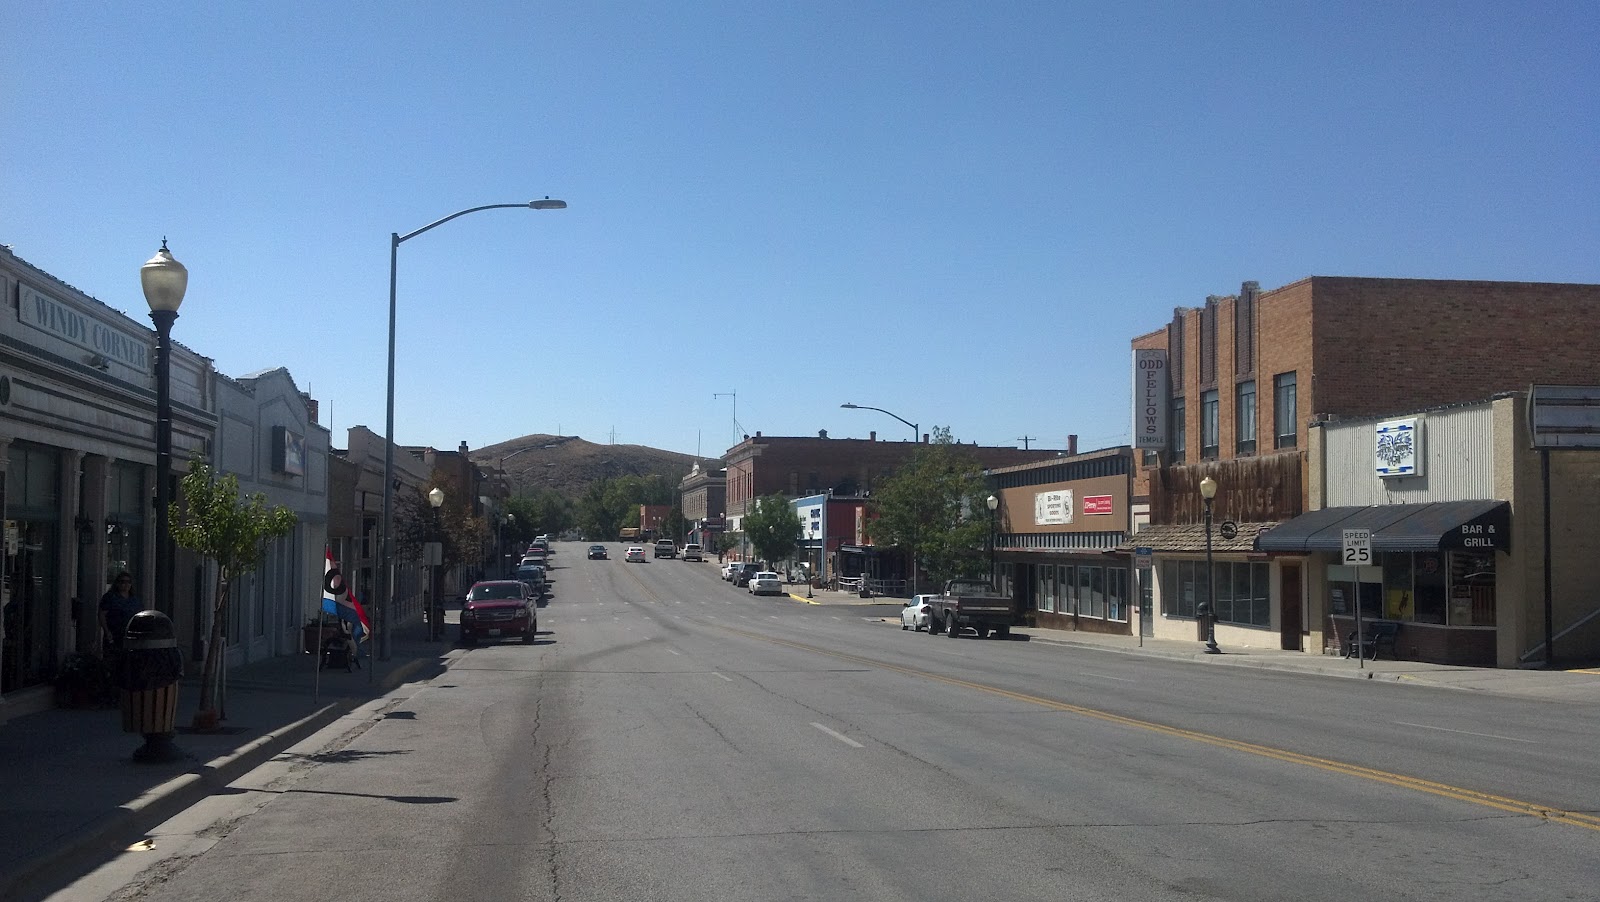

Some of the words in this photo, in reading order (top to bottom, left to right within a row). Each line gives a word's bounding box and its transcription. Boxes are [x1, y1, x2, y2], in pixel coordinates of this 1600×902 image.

[34, 295, 89, 344] WINDY
[93, 324, 146, 369] CORNER
[1139, 360, 1163, 370] ODD
[1145, 370, 1157, 434] FELLOWS
[1139, 436, 1164, 444] TEMPLE
[1226, 487, 1275, 515] HOUSE
[1461, 524, 1483, 534] BAR
[1488, 524, 1496, 534] &
[1464, 537, 1495, 547] GRILL
[1346, 548, 1369, 561] 25
